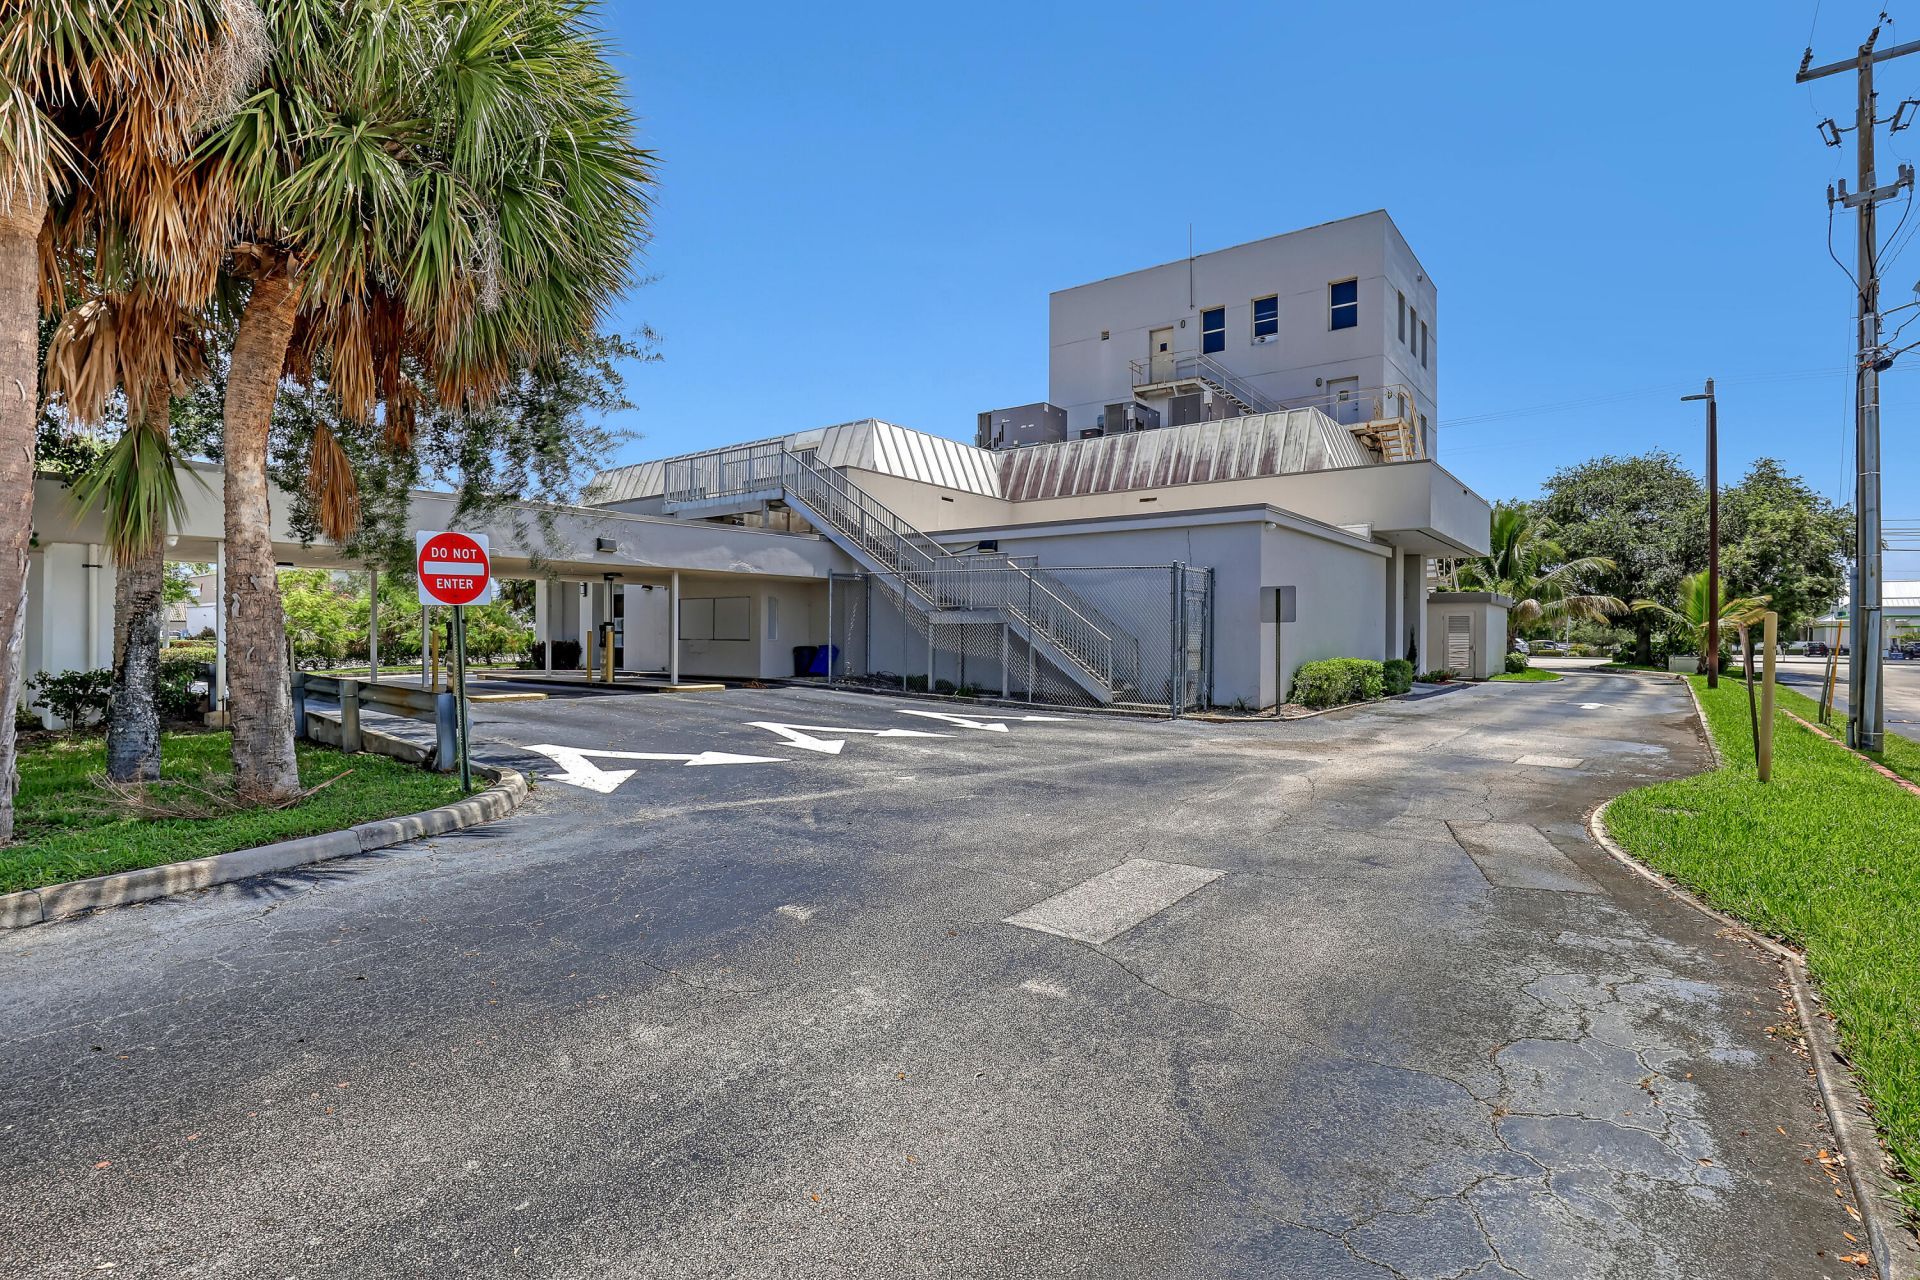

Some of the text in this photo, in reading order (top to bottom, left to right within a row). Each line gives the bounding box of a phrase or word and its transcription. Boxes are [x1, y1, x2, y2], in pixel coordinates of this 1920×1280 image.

[431, 547, 477, 559] DO NOT
[436, 578, 473, 589] ENTER
